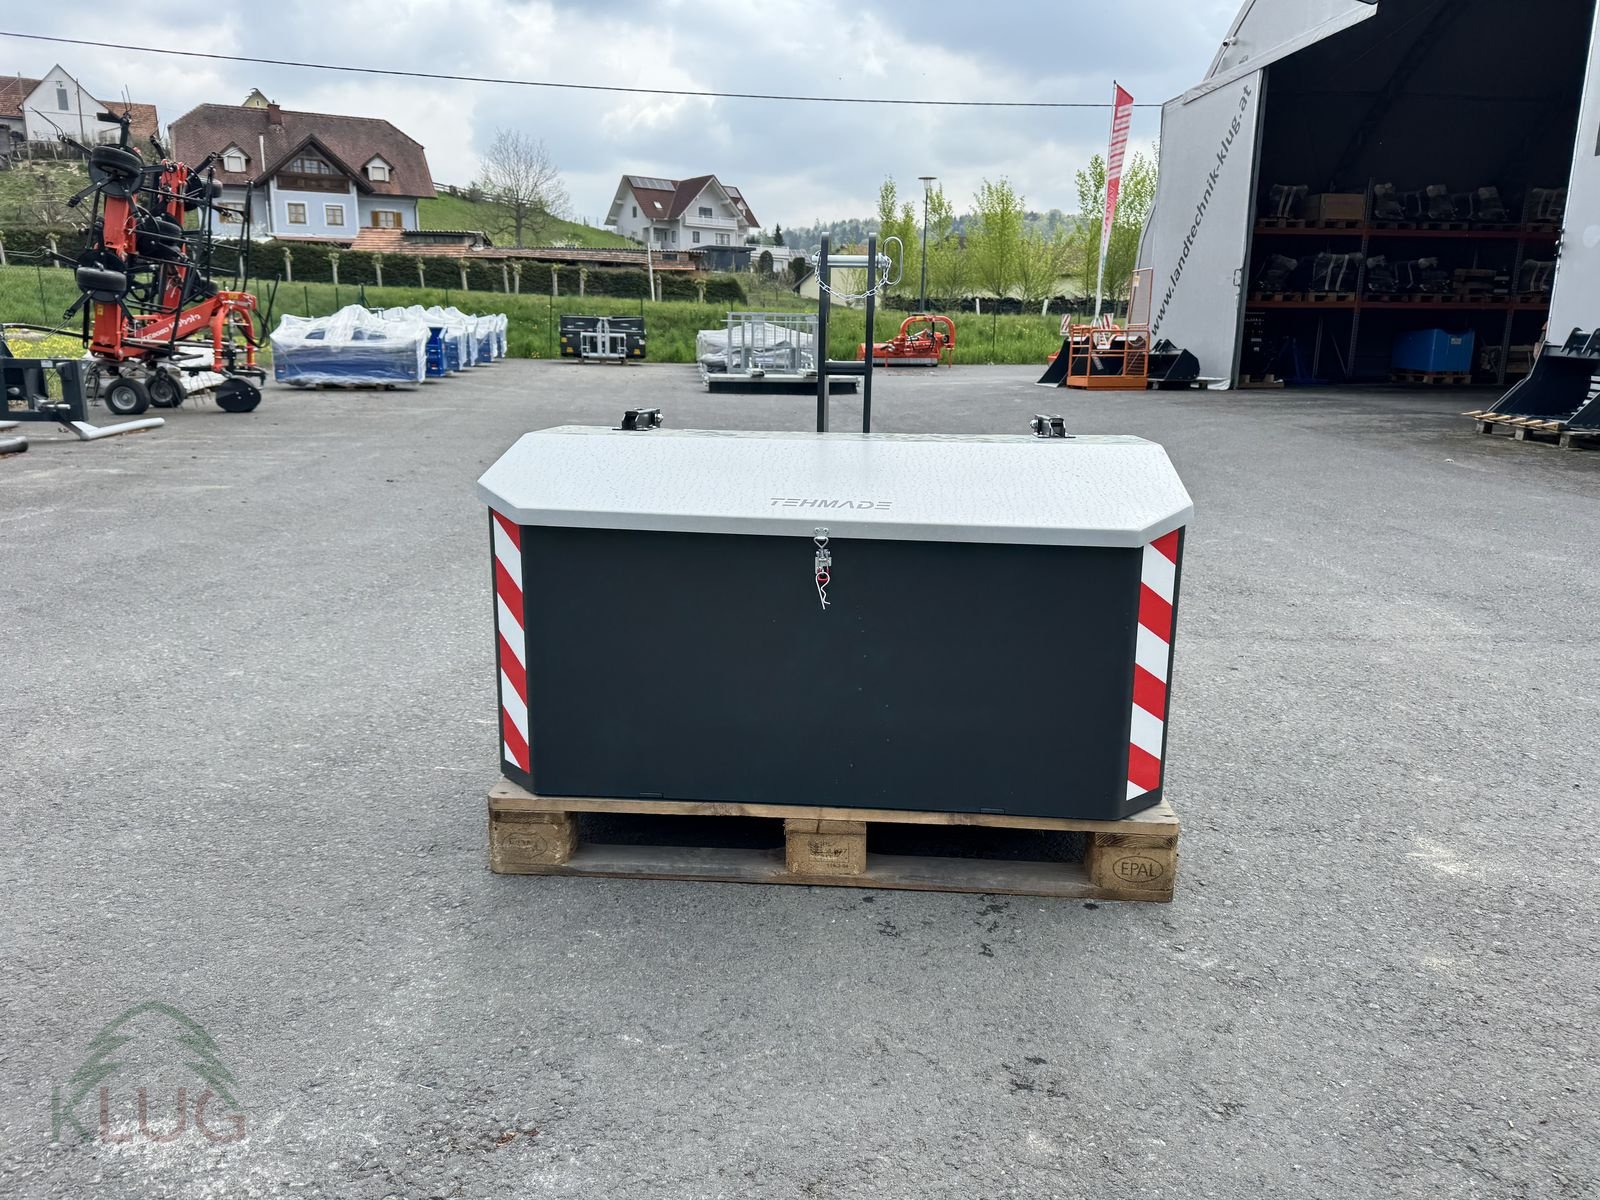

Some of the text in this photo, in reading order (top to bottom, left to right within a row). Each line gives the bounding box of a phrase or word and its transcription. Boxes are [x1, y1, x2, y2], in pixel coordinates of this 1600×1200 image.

[1151, 84, 1252, 337] www.landtechnik-klug.at
[770, 497, 893, 510] TEHMADE
[1120, 861, 1157, 877] EPAL
